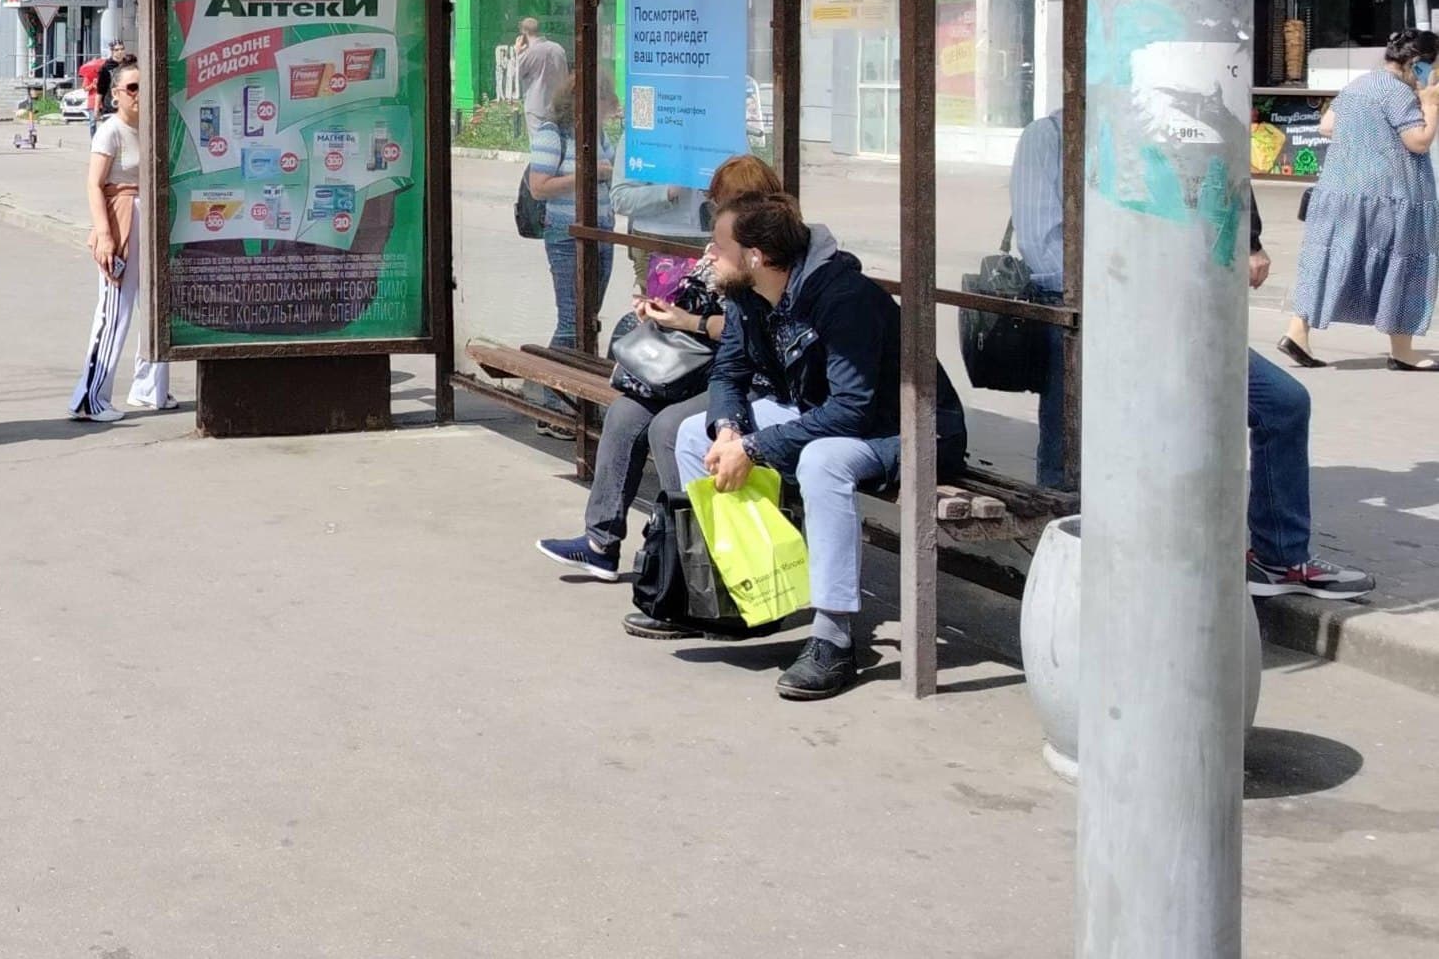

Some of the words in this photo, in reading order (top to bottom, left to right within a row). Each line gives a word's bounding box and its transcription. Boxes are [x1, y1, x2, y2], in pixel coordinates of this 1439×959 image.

[633, 6, 699, 25] Посмотрите,
[634, 32, 665, 43] когда
[664, 30, 709, 46] приедет
[197, 50, 219, 69] НА
[222, 35, 271, 58] ВОЛНЕ
[634, 50, 654, 64] ваш
[656, 51, 712, 68] транспорт
[198, 53, 260, 83] СКИДОК
[259, 105, 274, 116] 20
[211, 142, 225, 152] 20
[282, 157, 296, 168] 20
[171, 283, 216, 304] МЕЮТСЯ
[335, 280, 408, 300] НЕОБХОДИМО
[172, 305, 230, 327] ОЛУЧЕНИЕ
[236, 303, 323, 325] КОНСУЛЬТАЦИИ
[329, 301, 408, 323] СПЕЦИАЛИСТА
